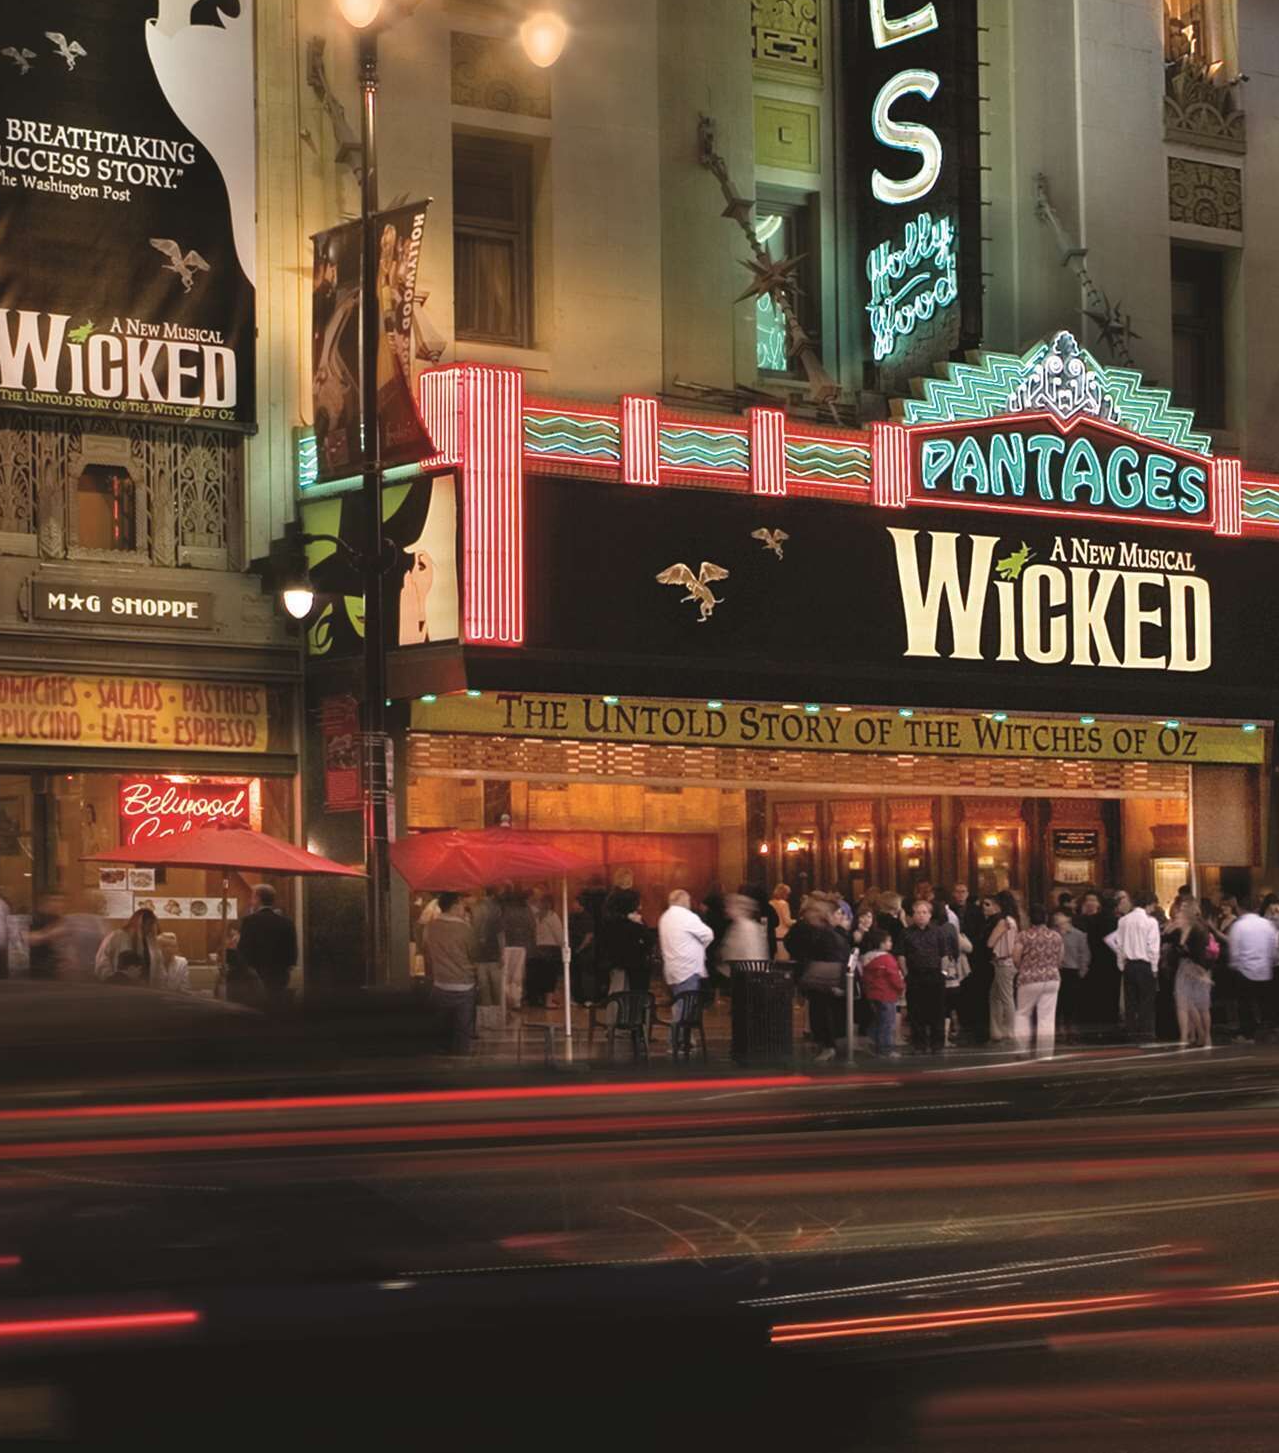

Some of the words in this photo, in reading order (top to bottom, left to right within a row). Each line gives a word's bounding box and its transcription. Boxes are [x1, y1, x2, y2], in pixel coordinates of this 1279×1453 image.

[6, 117, 196, 165] BREATHTAKING
[21, 174, 99, 200] Washington
[103, 185, 131, 202] Post
[97, 159, 184, 190] STORY.”
[402, 213, 425, 329] HOLLYWOOD
[866, 212, 955, 304] Holly
[865, 252, 957, 361] Wood
[110, 317, 122, 333] A
[126, 319, 160, 338] NEW
[162, 322, 224, 345] MUSICAL
[0, 389, 24, 402] THE
[25, 391, 74, 408] UNTOLD
[75, 395, 110, 411] STORY
[113, 401, 127, 412] OF
[128, 401, 150, 414] THE
[152, 403, 201, 418] WITCHES
[203, 408, 217, 420] OF
[219, 409, 236, 421] OZ
[922, 433, 1207, 514] PANTAGES
[1050, 537, 1067, 562] A
[1071, 538, 1115, 566] NEW
[1119, 541, 1196, 572] MUSICAL
[111, 597, 199, 619] SHOPPE
[97, 678, 163, 711] SALADS
[182, 683, 260, 716] PASTRIES
[101, 713, 157, 745] LATTE
[174, 716, 257, 748] ESPRESSO
[496, 694, 569, 730] THE
[583, 698, 728, 738] UNTOLD
[740, 707, 841, 744] STORY
[854, 718, 892, 745] OF
[904, 720, 960, 748] THE
[972, 718, 1102, 754] WITCHES
[1113, 729, 1147, 754] OF
[1157, 724, 1198, 756] OZ
[123, 783, 246, 819] Belwood
